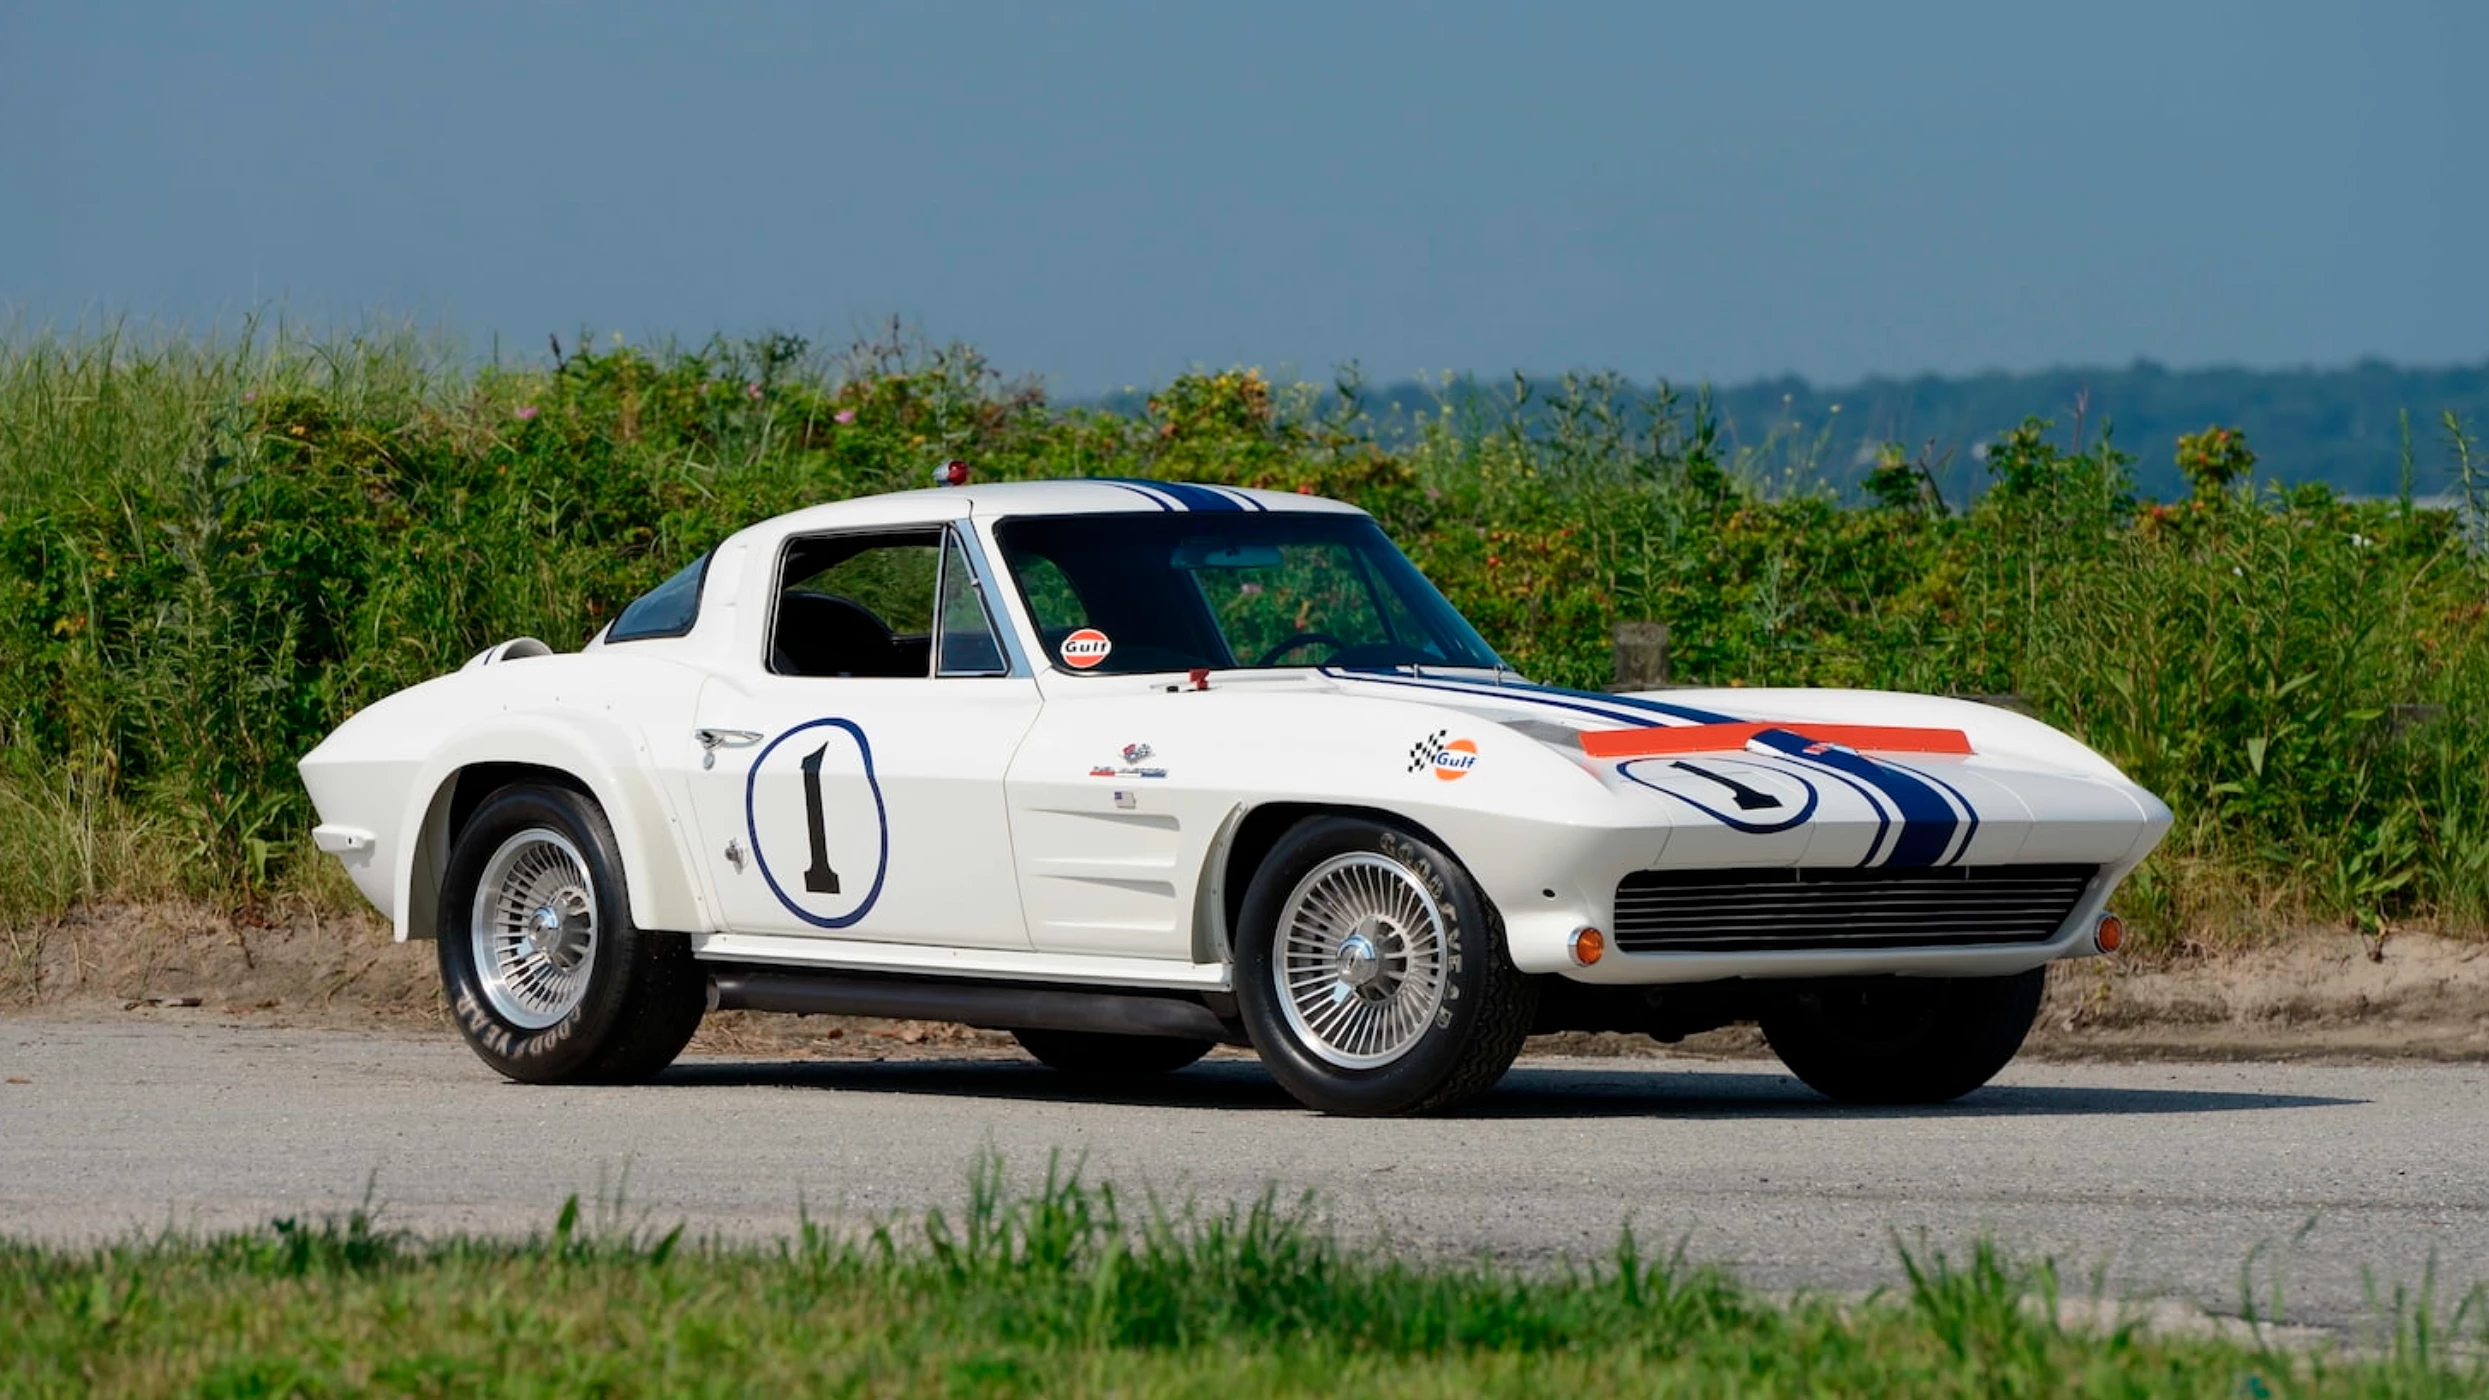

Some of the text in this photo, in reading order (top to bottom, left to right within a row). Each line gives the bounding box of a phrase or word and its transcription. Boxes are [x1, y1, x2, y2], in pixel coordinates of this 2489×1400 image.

[1065, 641, 1107, 652] Gulf
[1436, 752, 1476, 768] Gulf
[1669, 761, 1783, 810] 1
[801, 741, 840, 893] 1
